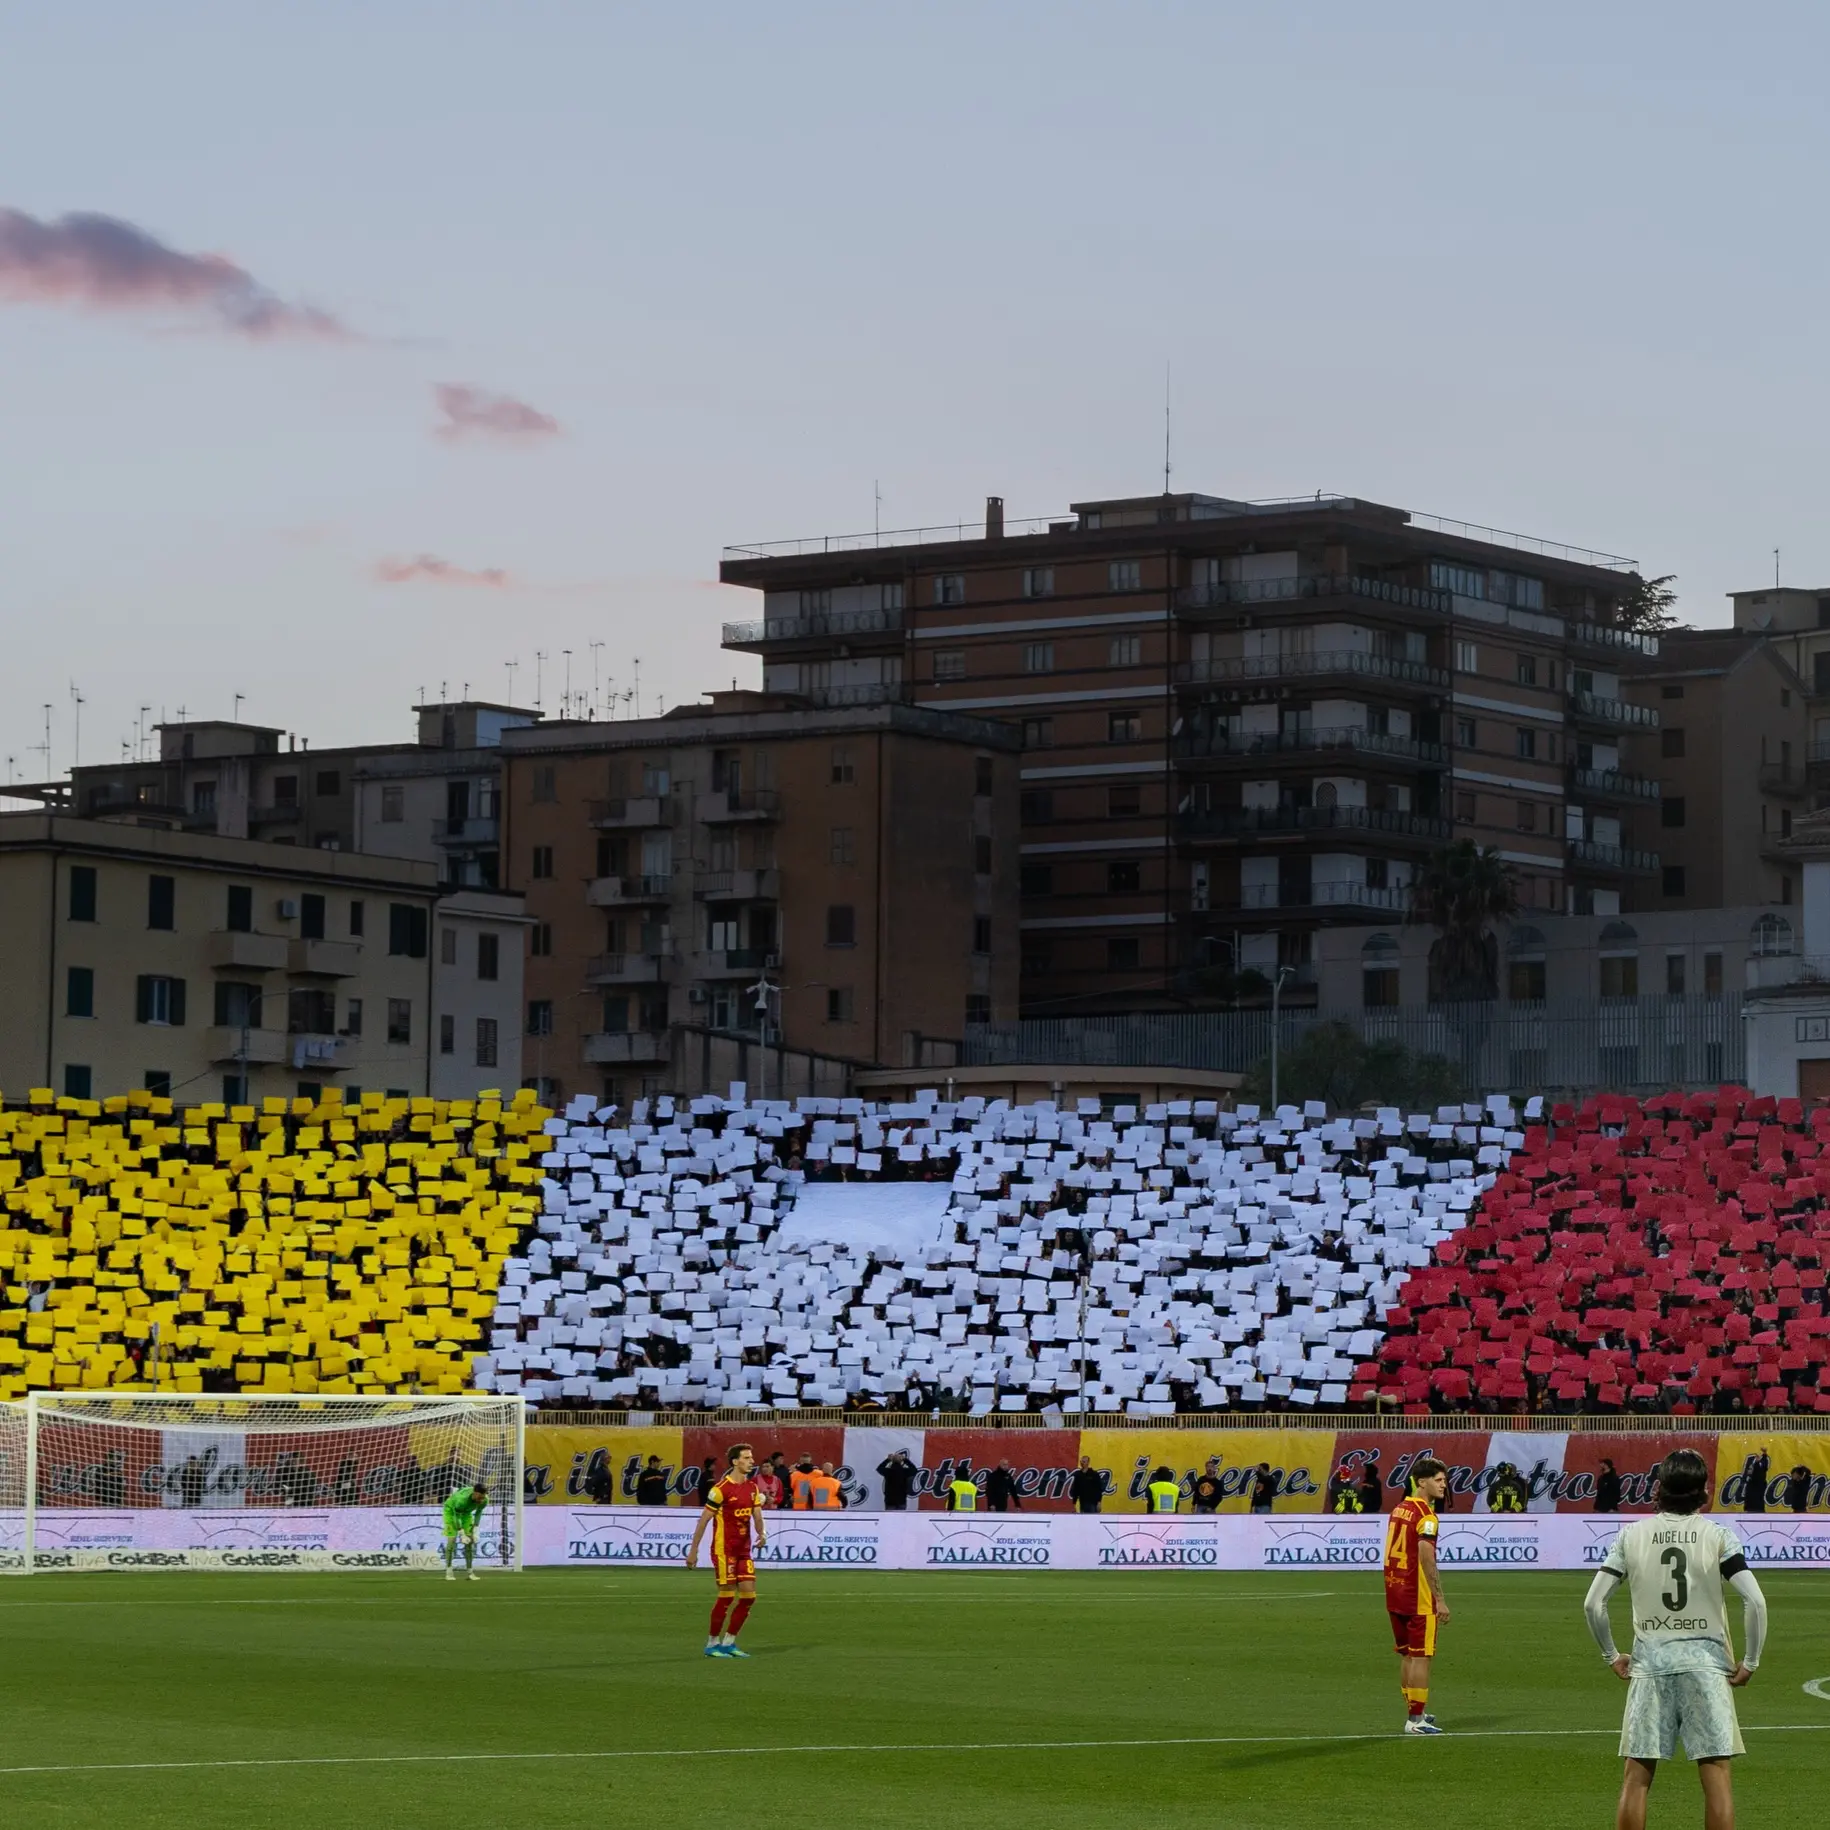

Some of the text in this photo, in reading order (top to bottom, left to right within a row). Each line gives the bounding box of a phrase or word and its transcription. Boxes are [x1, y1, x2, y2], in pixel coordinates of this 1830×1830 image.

[1446, 1458, 1598, 1502] notro
[1384, 1521, 1408, 1569] 14
[1652, 1531, 1697, 1544] AUGELLO
[108, 1552, 189, 1566] GoldBet
[222, 1552, 301, 1566] GoldBet
[332, 1553, 409, 1566] GoldBet
[752, 1545, 877, 1561] TALARICO
[927, 1546, 1049, 1563] TALARICO
[1099, 1548, 1217, 1563] TALARICO
[1265, 1547, 1380, 1562] TALARICO
[746, 1559, 755, 1574] 8
[1660, 1547, 1688, 1612] 3
[1642, 1616, 1708, 1631] inX.aero
